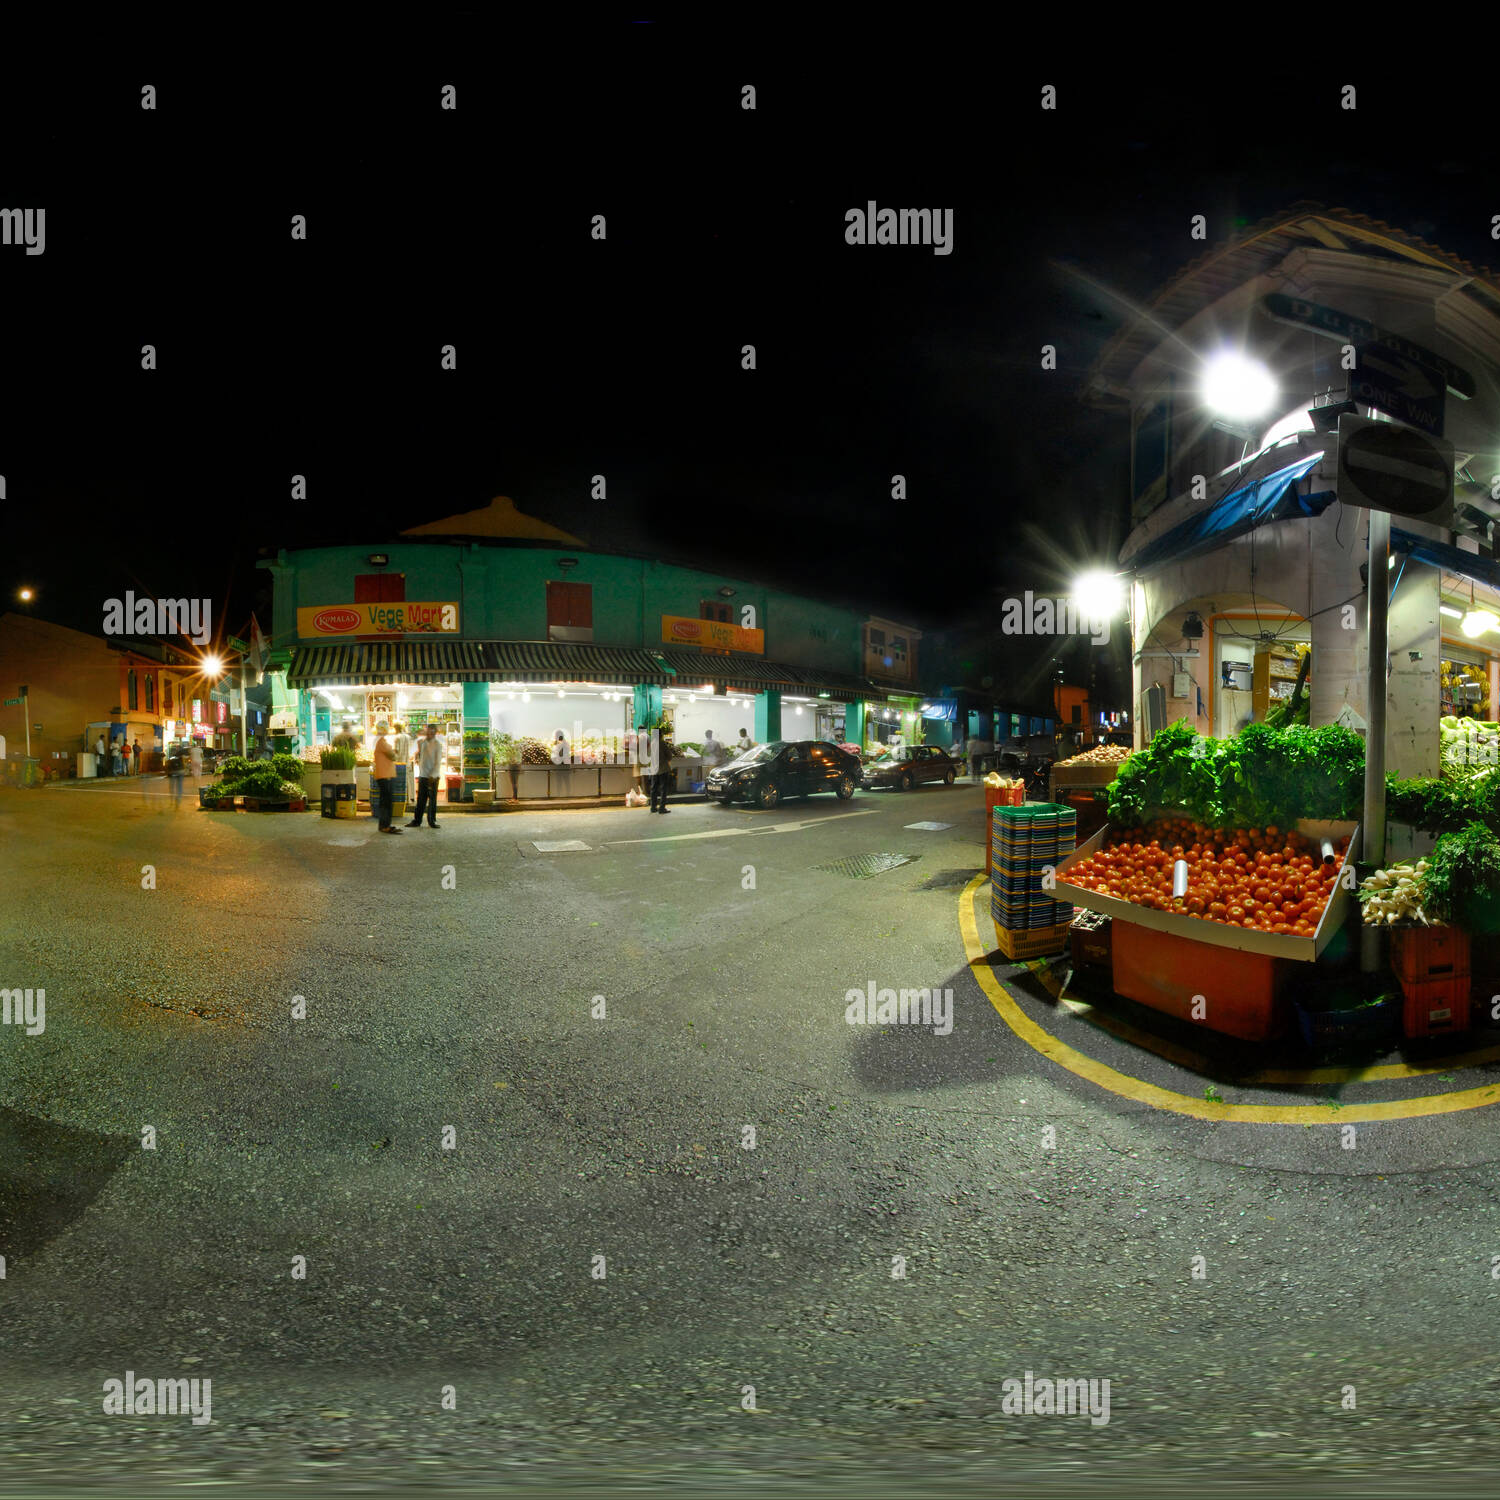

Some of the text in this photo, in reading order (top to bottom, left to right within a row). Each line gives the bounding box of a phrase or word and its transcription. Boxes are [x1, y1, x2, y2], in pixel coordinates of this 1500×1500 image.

[1360, 382, 1440, 428] ONE WAY
[318, 615, 356, 627] KOMALAS
[368, 606, 404, 629] Vege
